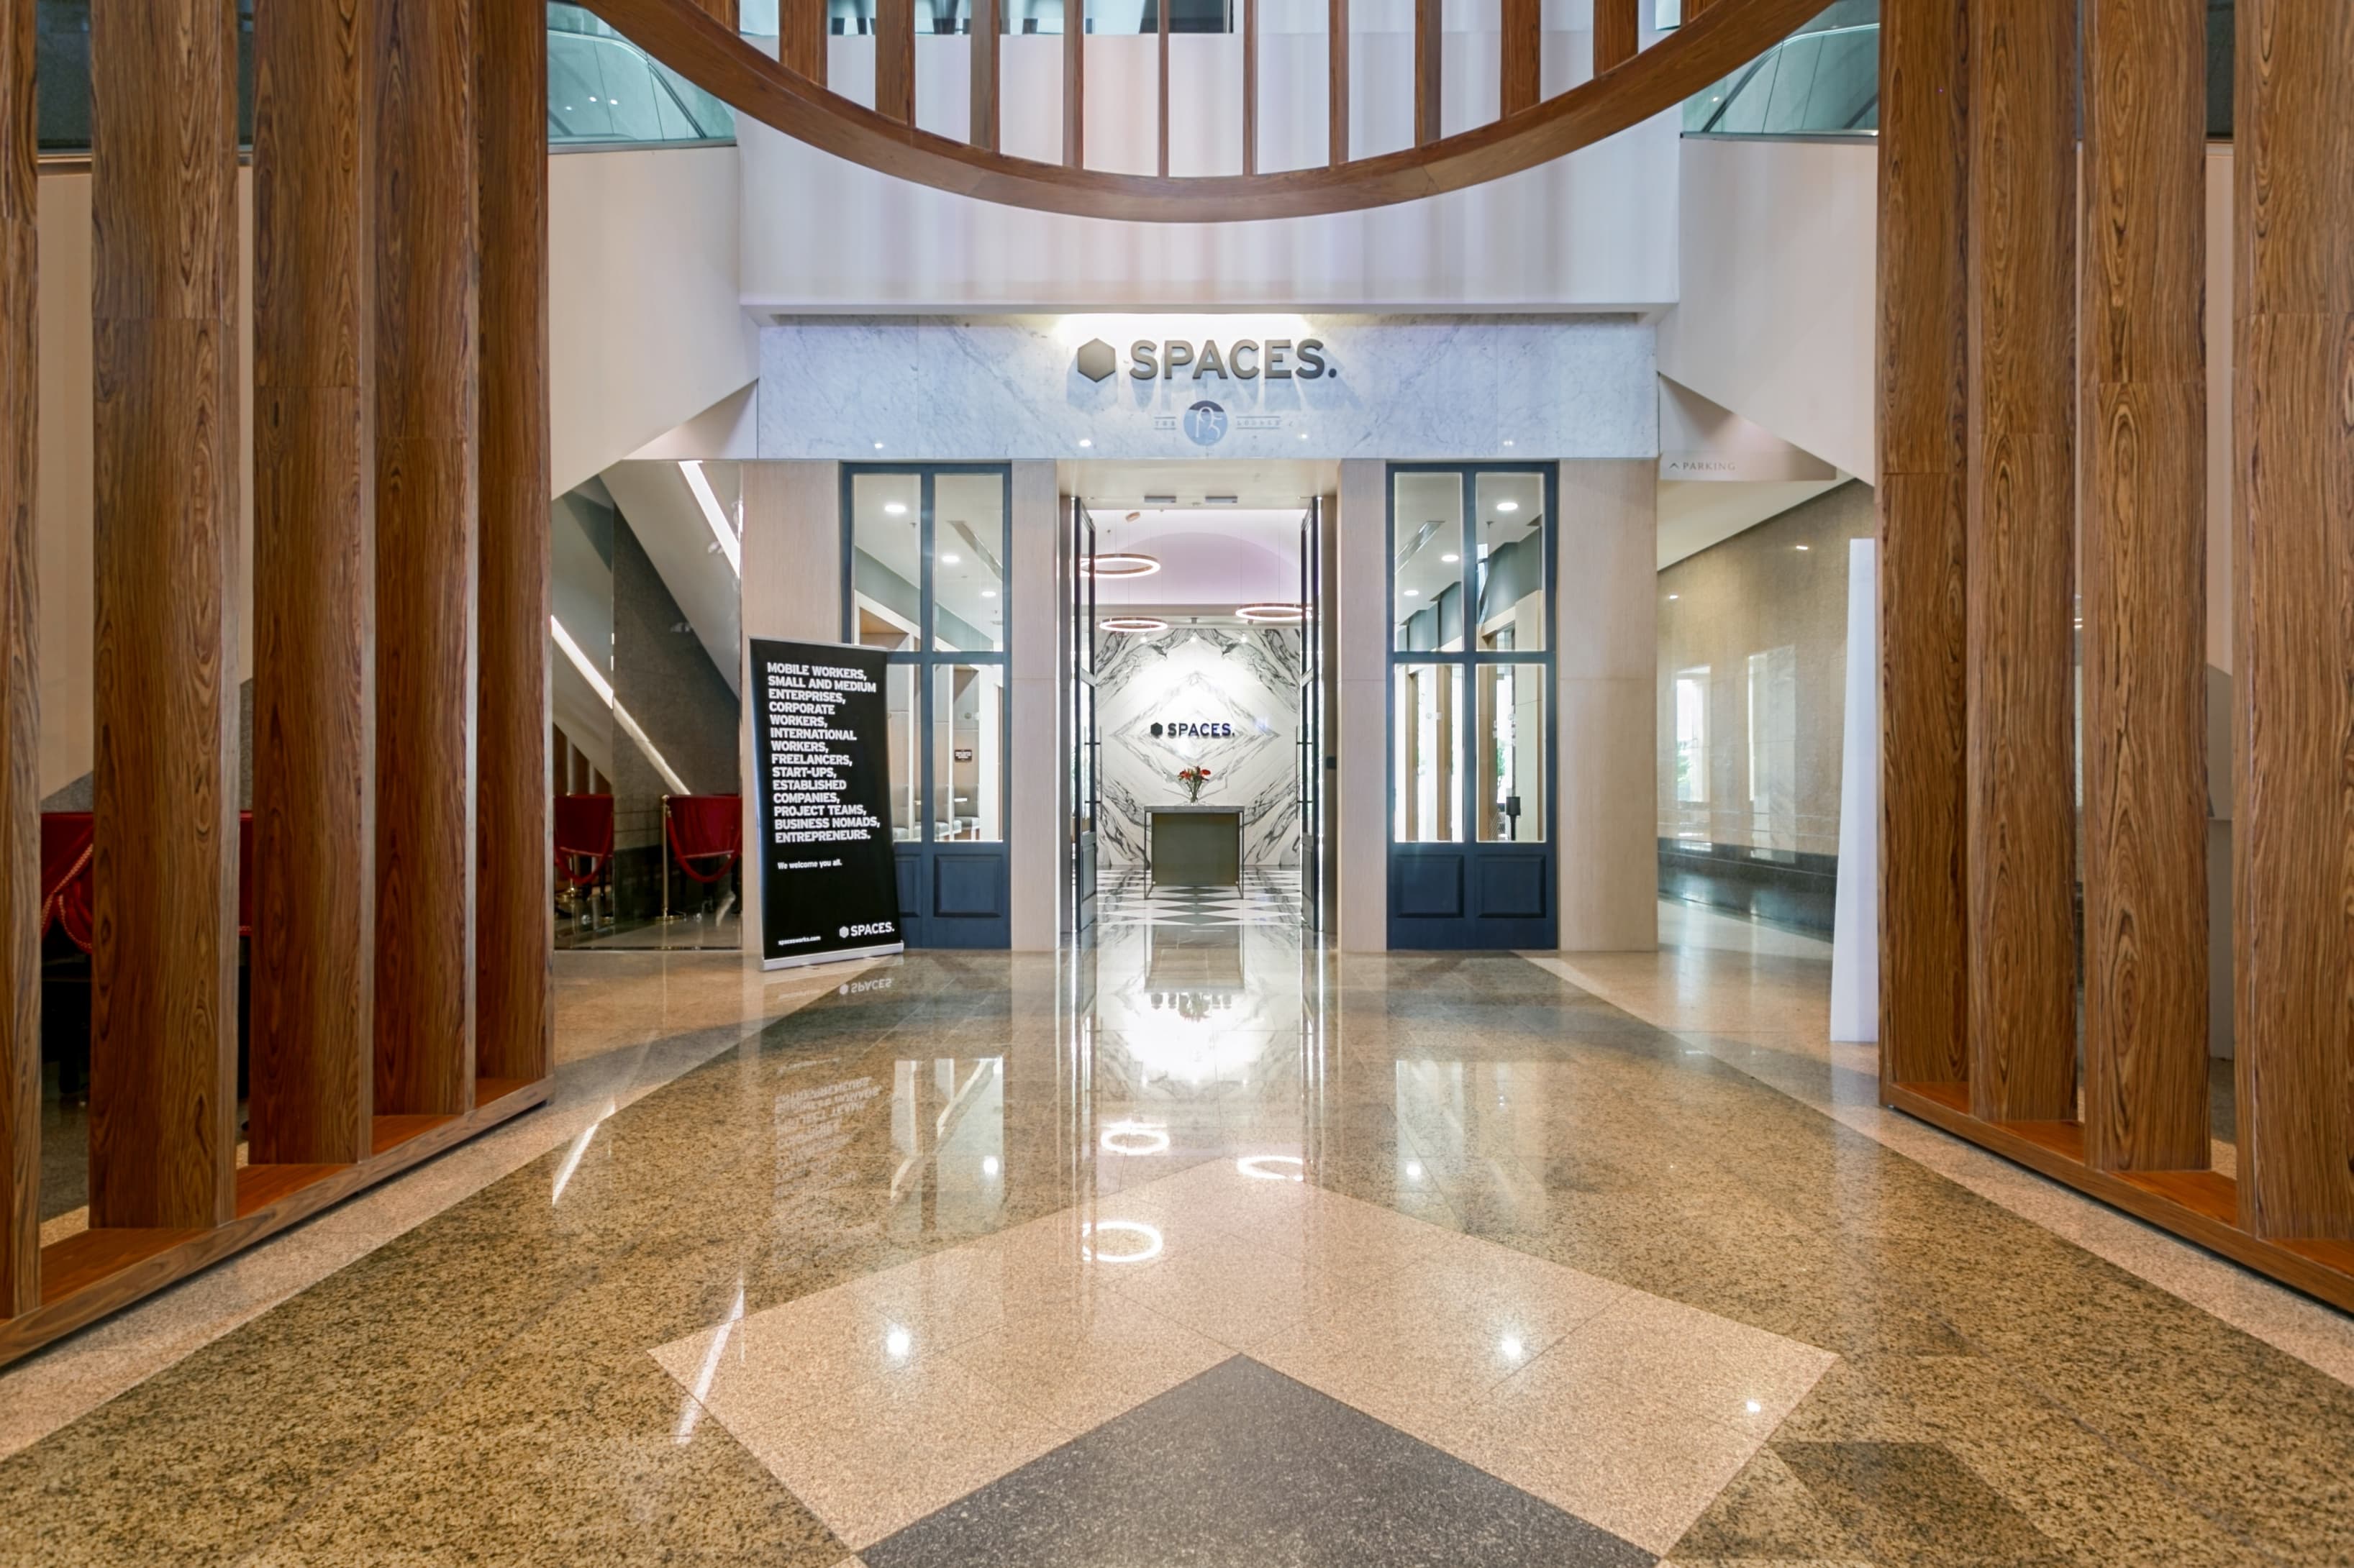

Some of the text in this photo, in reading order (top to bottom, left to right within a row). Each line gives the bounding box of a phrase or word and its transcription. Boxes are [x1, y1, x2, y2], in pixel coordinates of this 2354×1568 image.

[1129, 338, 1337, 380] SPACES.
[1682, 461, 1736, 471] PARKING
[767, 662, 867, 680] MOBILE WORKERS,
[768, 675, 876, 693] SMALL AND MEDIUM
[768, 688, 846, 704] ENTERPRISES,
[769, 701, 835, 715] CORPORATE
[770, 714, 827, 728] WORKERS,
[770, 727, 858, 741] INTERNATIONAL
[1167, 722, 1235, 737] SPACES.
[771, 740, 829, 753] WORKERS,
[771, 754, 853, 767] FREELANCERS,
[772, 767, 837, 778] START-UPS,
[773, 780, 847, 790] ESTABLISHED
[773, 792, 840, 804] COMPANIES,
[773, 804, 867, 817] PROJECT TEAMS,
[774, 816, 881, 830] BUSINESS NOMADS,
[775, 829, 871, 844] ENTREPRENEURS.
[819, 860, 832, 869] you
[850, 921, 895, 937] SPACES.
